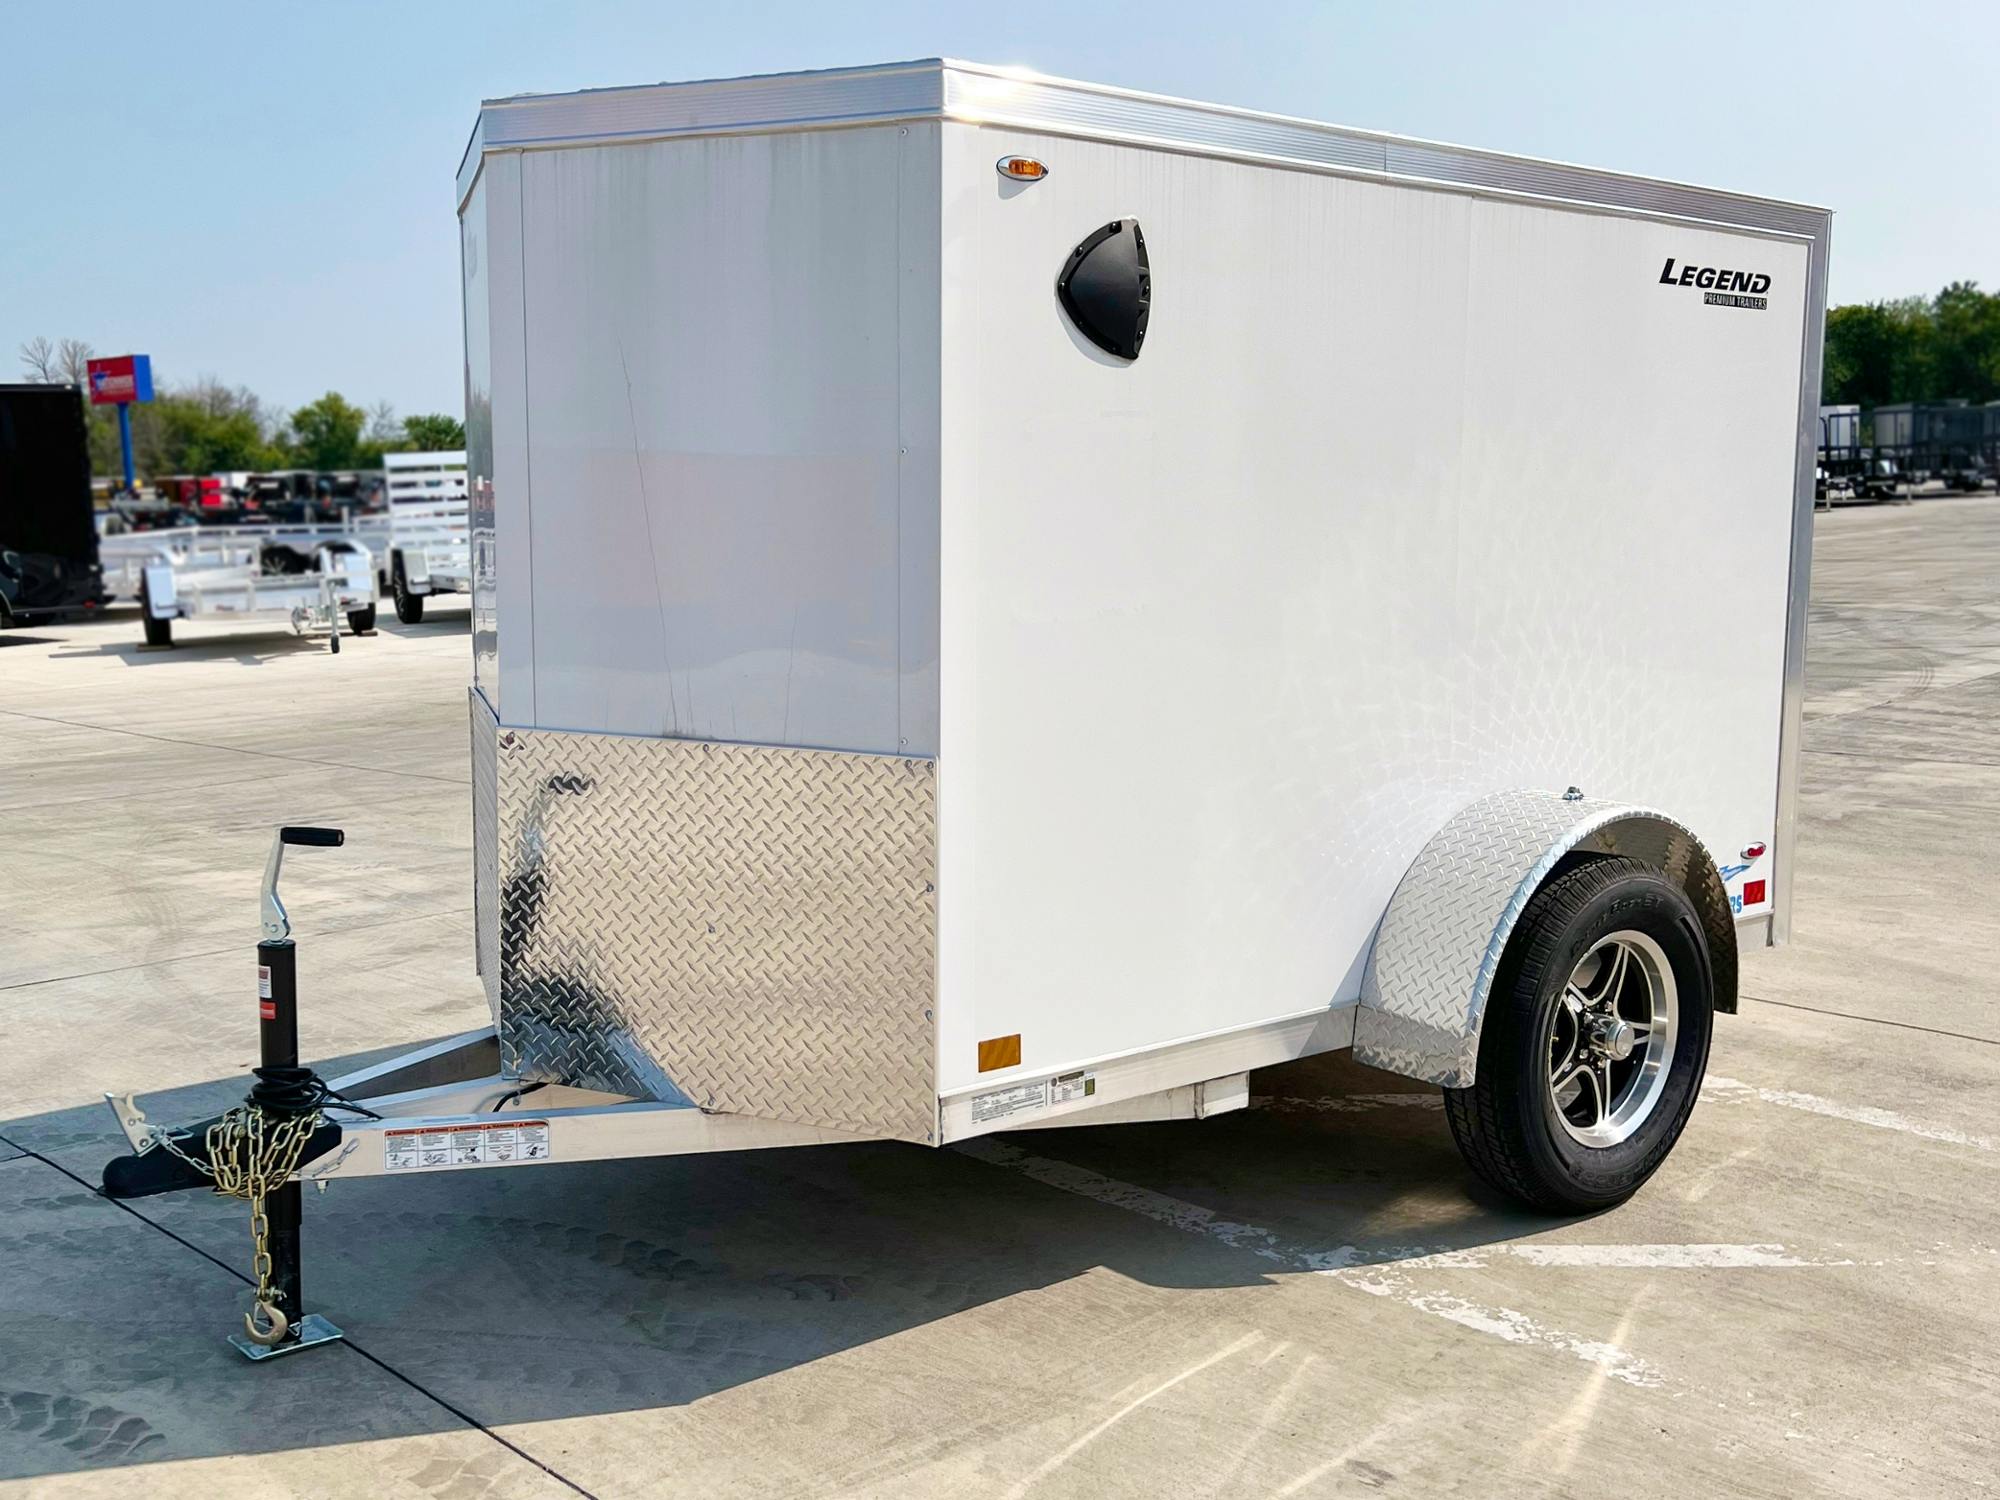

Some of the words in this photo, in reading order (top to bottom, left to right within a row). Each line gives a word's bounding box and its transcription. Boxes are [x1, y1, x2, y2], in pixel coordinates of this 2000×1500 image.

[1659, 258, 1771, 294] LEGEND
[1704, 293, 1735, 307] PREMIUM
[1736, 296, 1767, 310] TRAILERS
